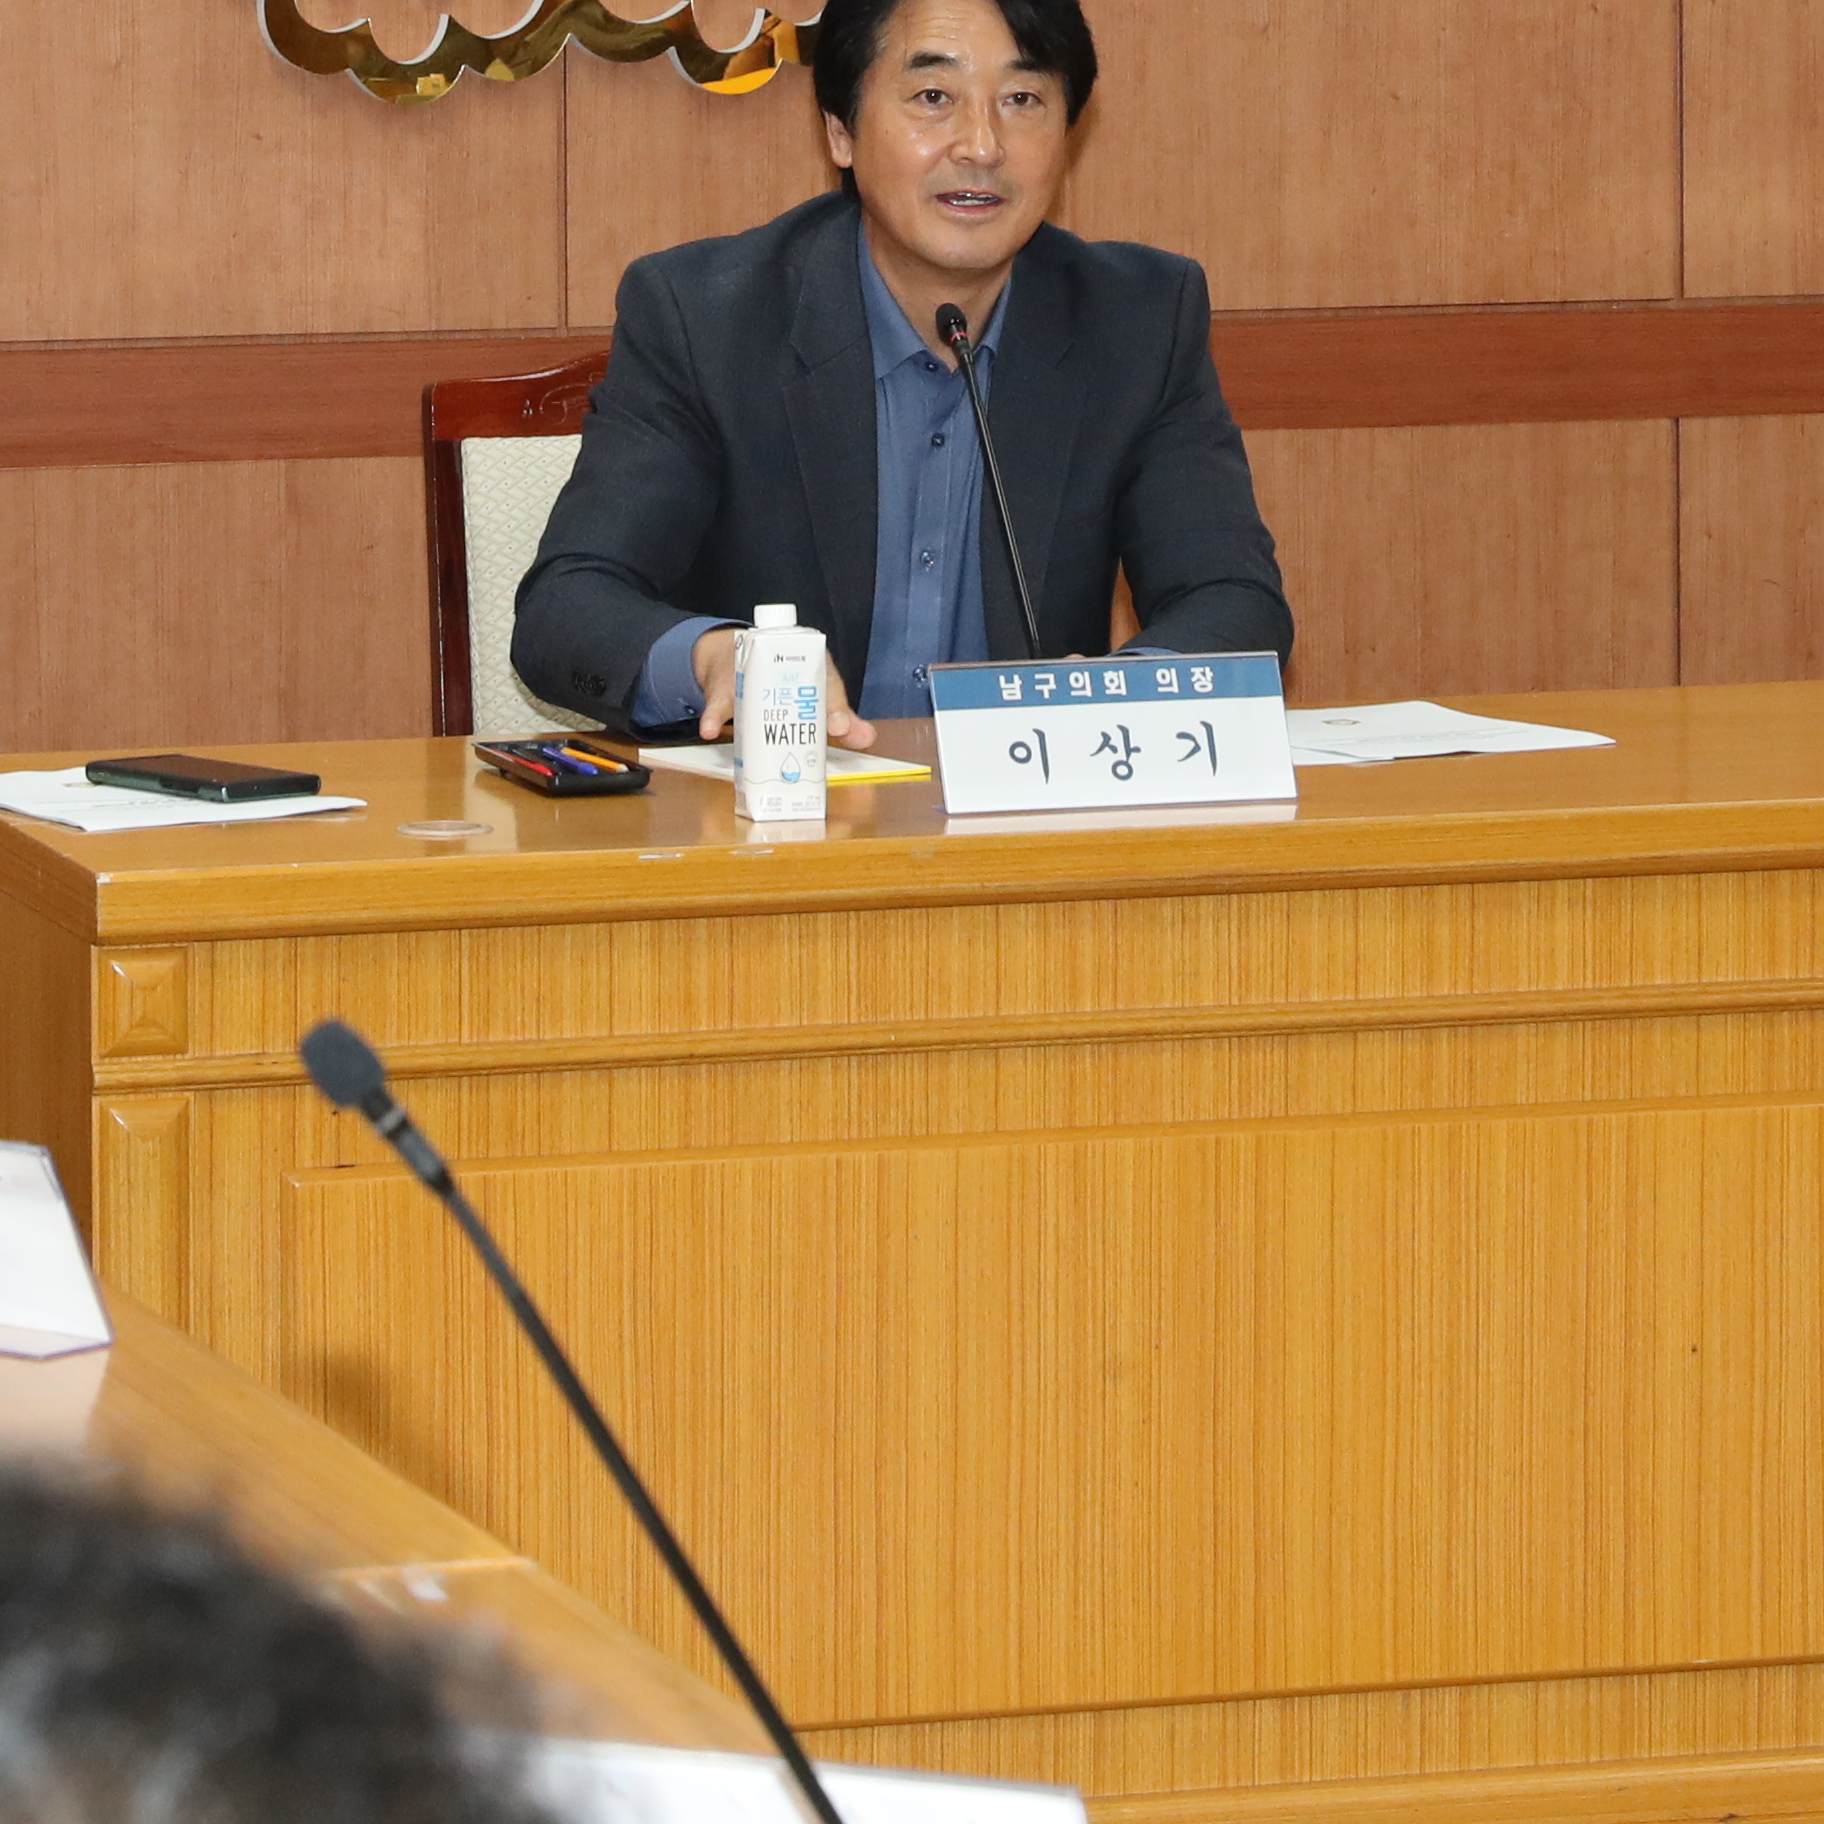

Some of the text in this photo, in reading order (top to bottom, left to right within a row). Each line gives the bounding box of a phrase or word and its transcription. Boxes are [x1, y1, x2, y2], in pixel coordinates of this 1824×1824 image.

[998, 666, 1214, 701] 남구의회 의장
[763, 709, 788, 722] DEEP
[764, 722, 817, 746] WATER
[1008, 720, 1218, 784] 이상기
